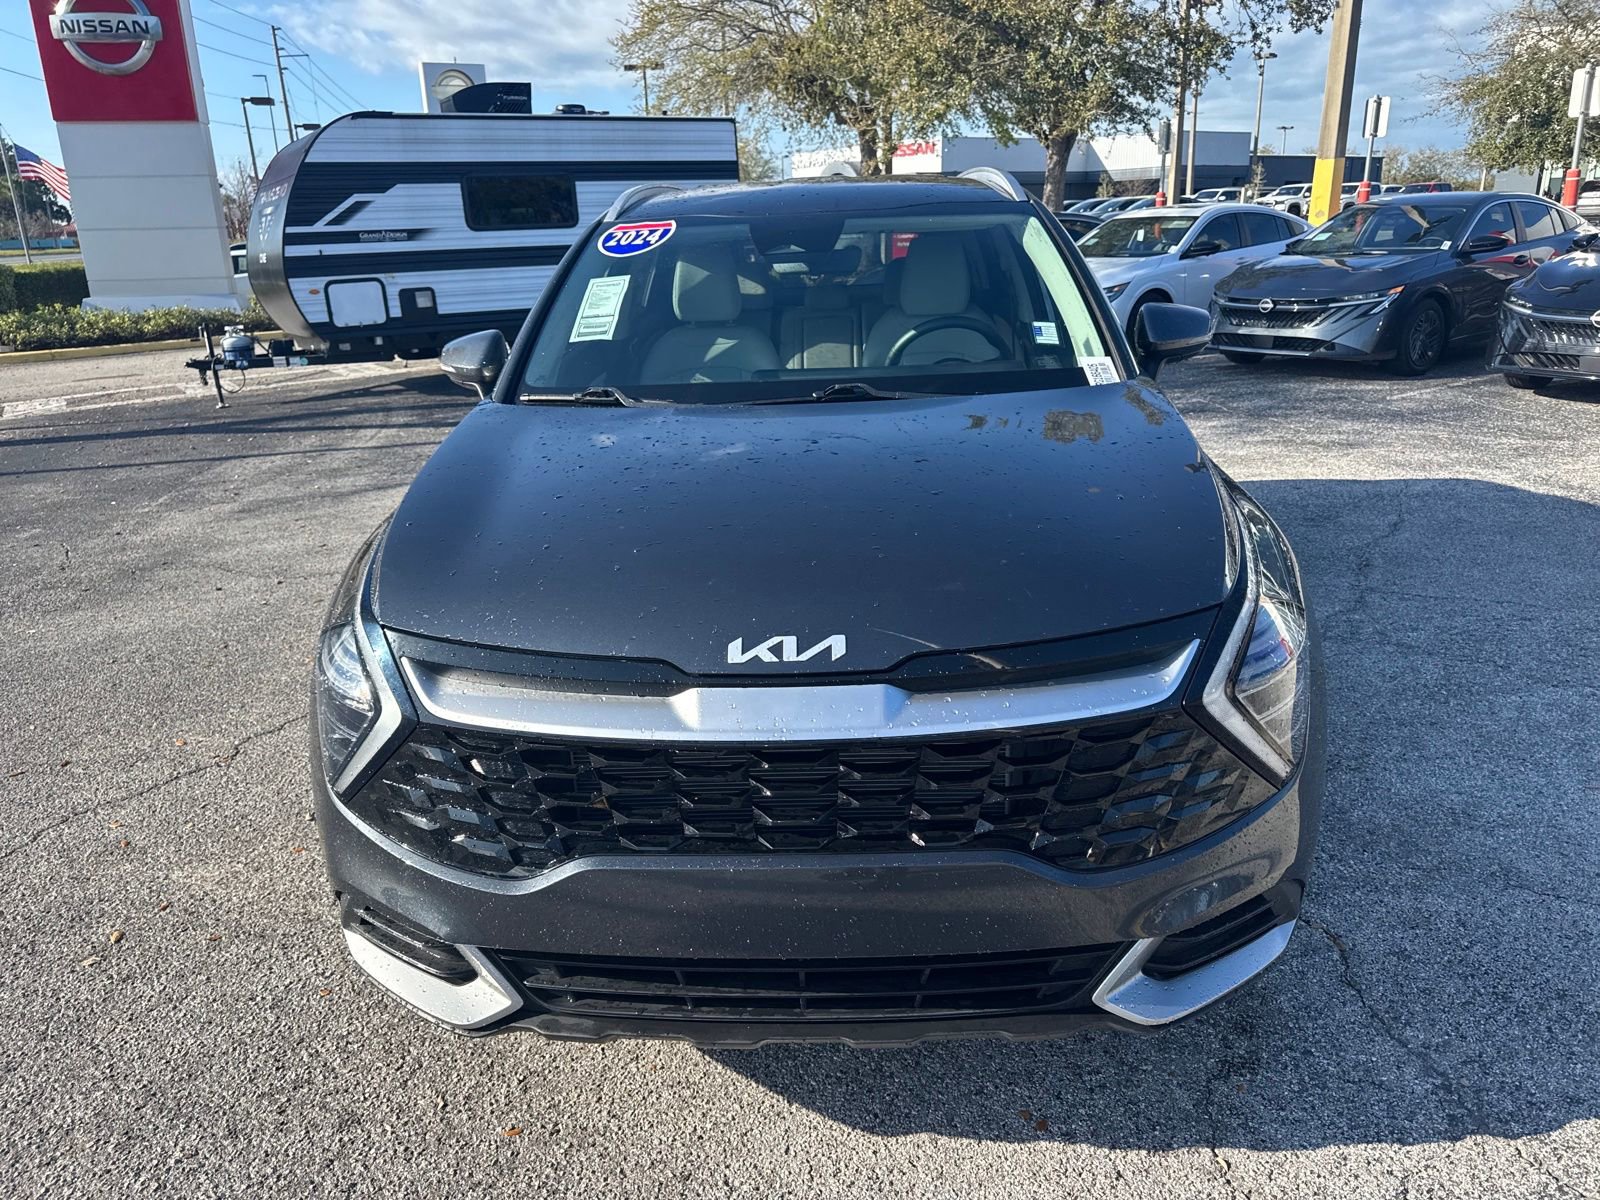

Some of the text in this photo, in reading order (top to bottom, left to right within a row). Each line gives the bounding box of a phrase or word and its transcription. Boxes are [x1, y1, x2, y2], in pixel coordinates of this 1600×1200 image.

[60, 18, 150, 34] NISSAN
[604, 228, 664, 246] 2024
[727, 634, 847, 664] KIA
